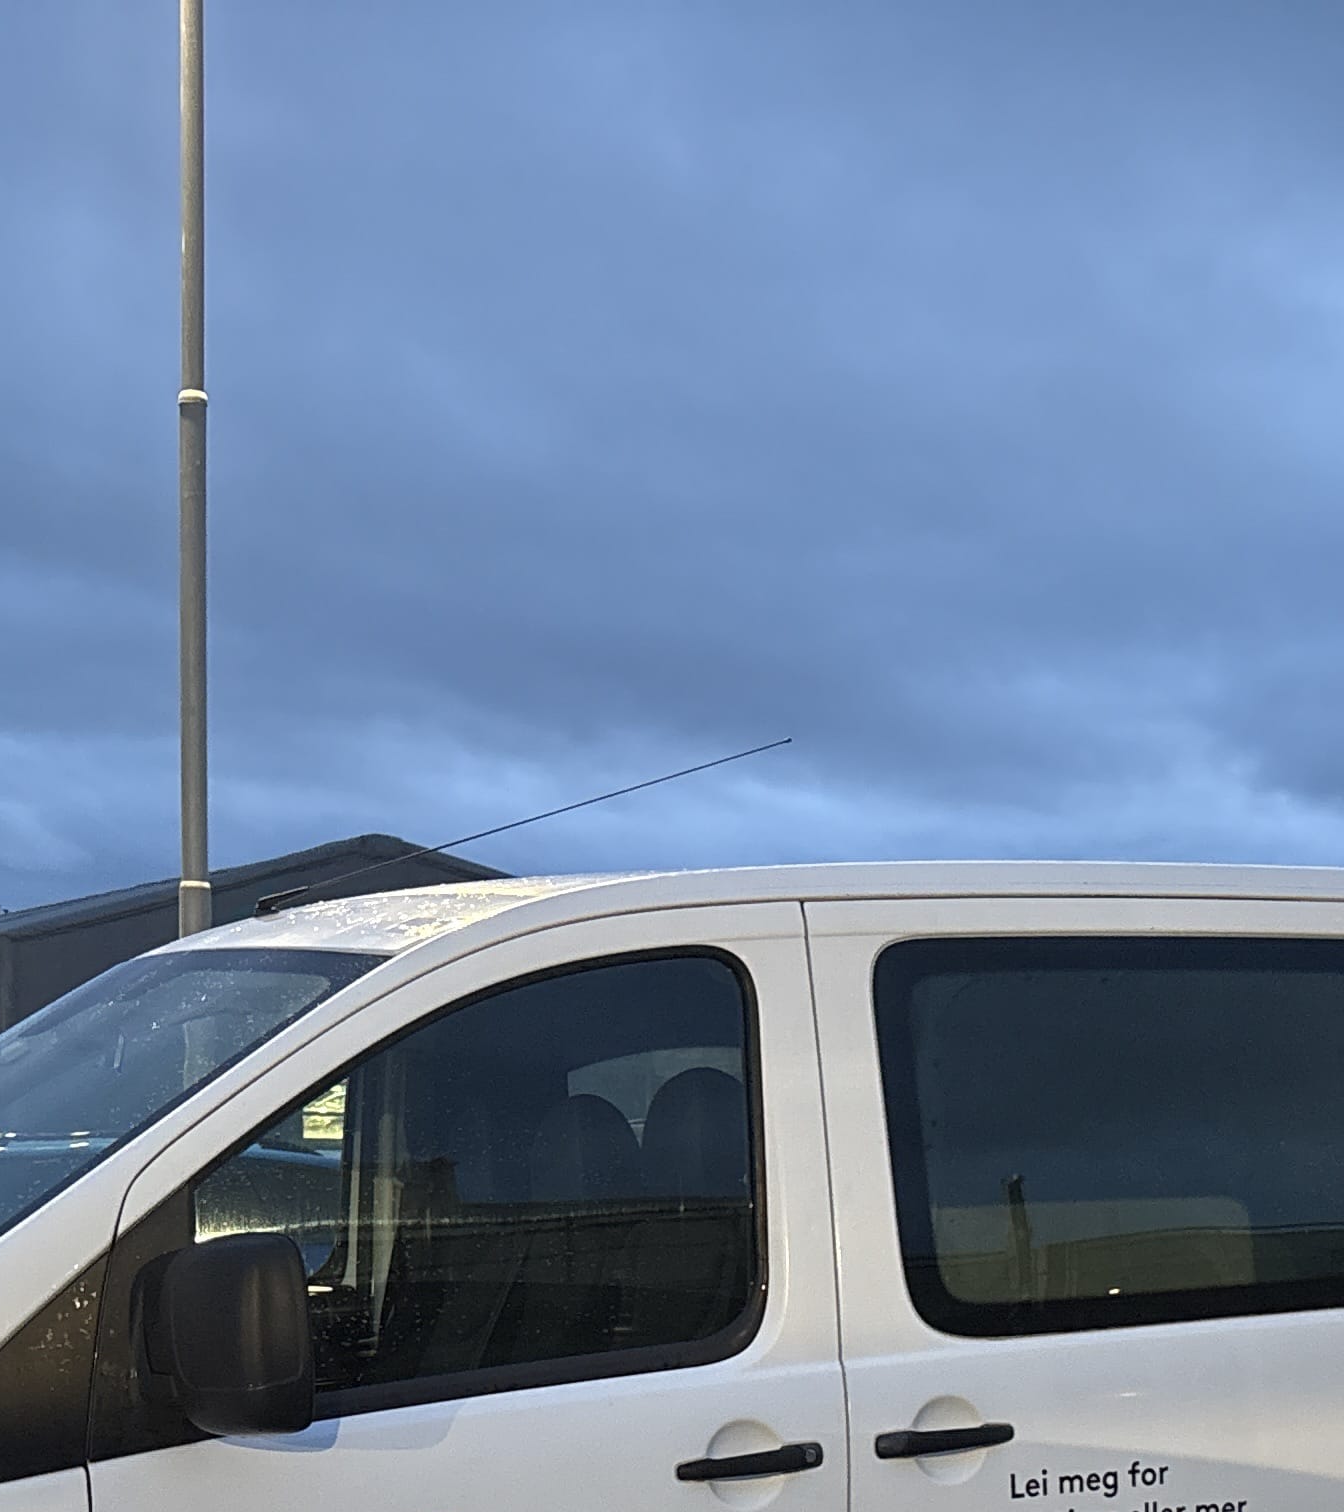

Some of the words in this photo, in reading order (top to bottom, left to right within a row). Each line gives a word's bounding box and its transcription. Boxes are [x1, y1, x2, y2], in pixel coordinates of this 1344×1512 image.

[1010, 1468, 1048, 1499] Lei
[1059, 1470, 1118, 1498] meg
[1128, 1461, 1169, 1487] for
